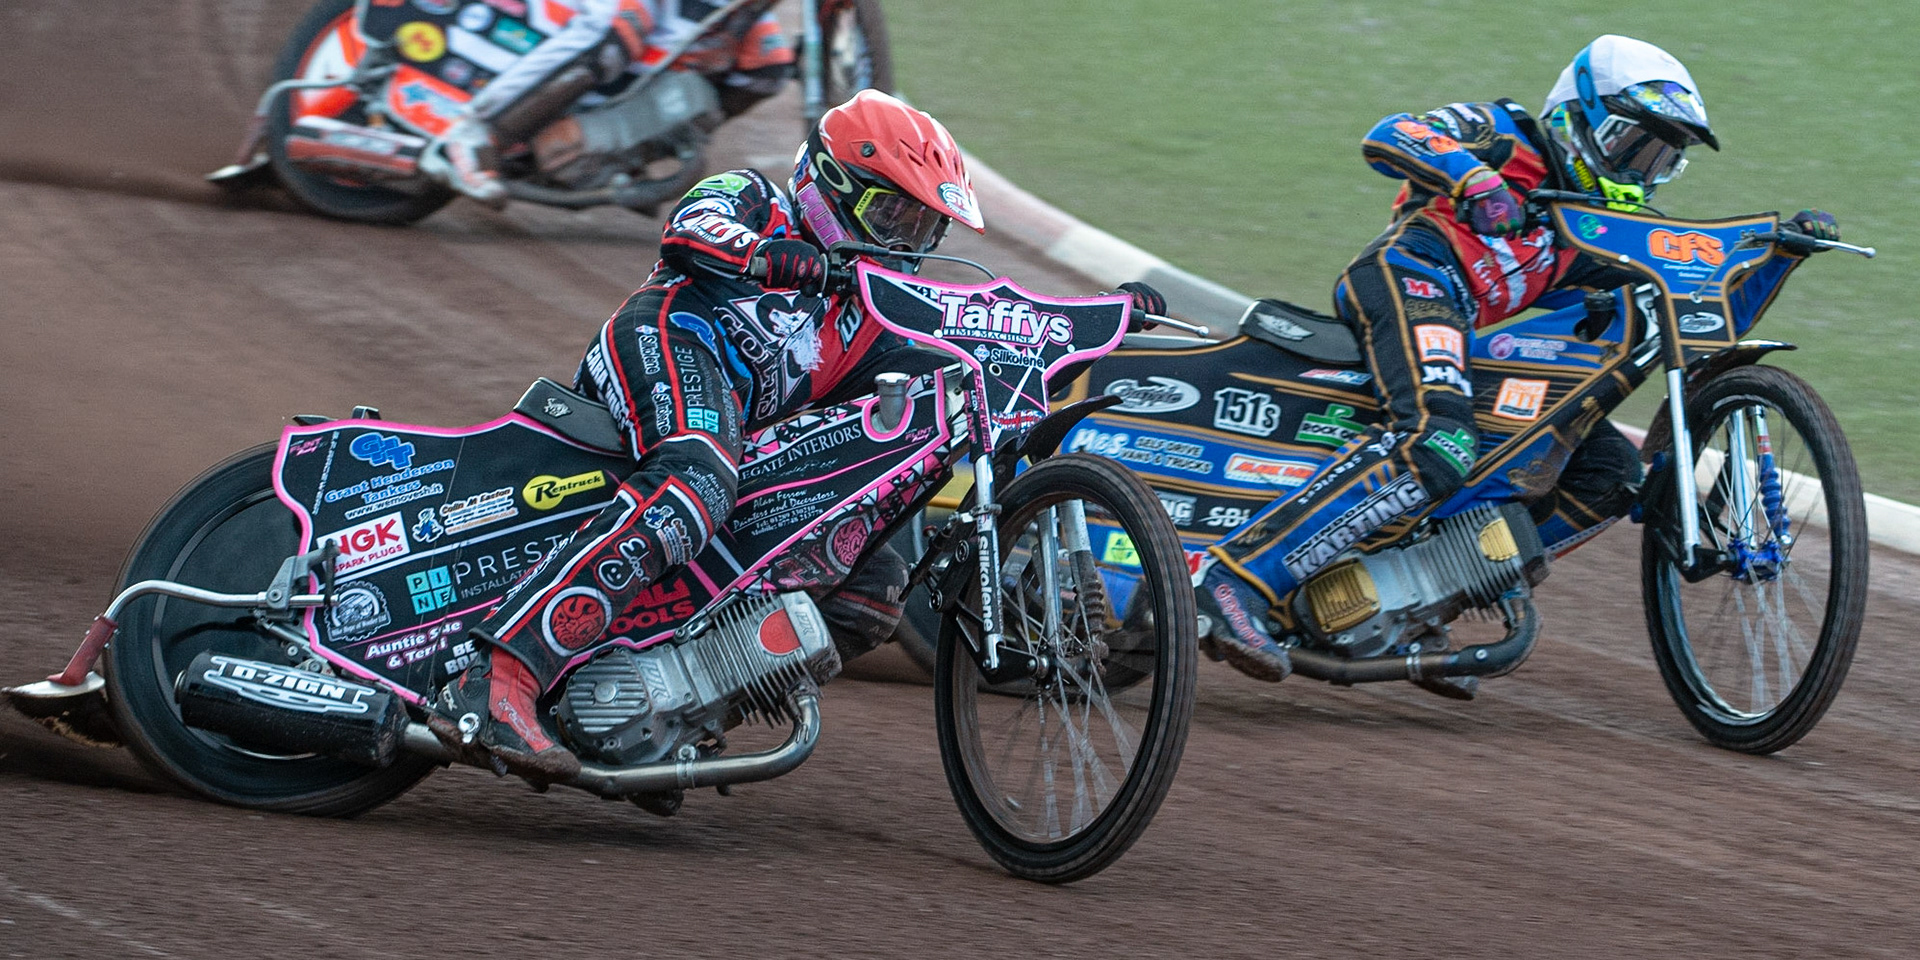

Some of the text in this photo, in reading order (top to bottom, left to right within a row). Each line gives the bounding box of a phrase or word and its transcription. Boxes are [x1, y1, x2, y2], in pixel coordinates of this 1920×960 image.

[1648, 230, 1725, 266] CFS
[940, 294, 1071, 345] Taffys
[991, 348, 1045, 368] Silkolene
[675, 346, 705, 407] PRESTIGE
[970, 390, 979, 411] LEON
[787, 423, 862, 462] INTERIORS
[1302, 423, 1339, 434] ROCK
[1135, 436, 1204, 457] SELF DRIVE
[1164, 454, 1213, 474] TRUCKS
[325, 459, 455, 503] Grant Henderson
[361, 480, 422, 504] Tankers
[529, 474, 602, 503] Rentruck
[753, 497, 774, 510] Alan
[770, 501, 788, 514] and
[1287, 480, 1427, 580] KARTING
[333, 544, 403, 574] SPARK PLUGS
[978, 537, 994, 632] Silkolene
[609, 600, 695, 634] OOLS
[367, 621, 461, 659] Auntie Sue
[388, 655, 401, 668] &
